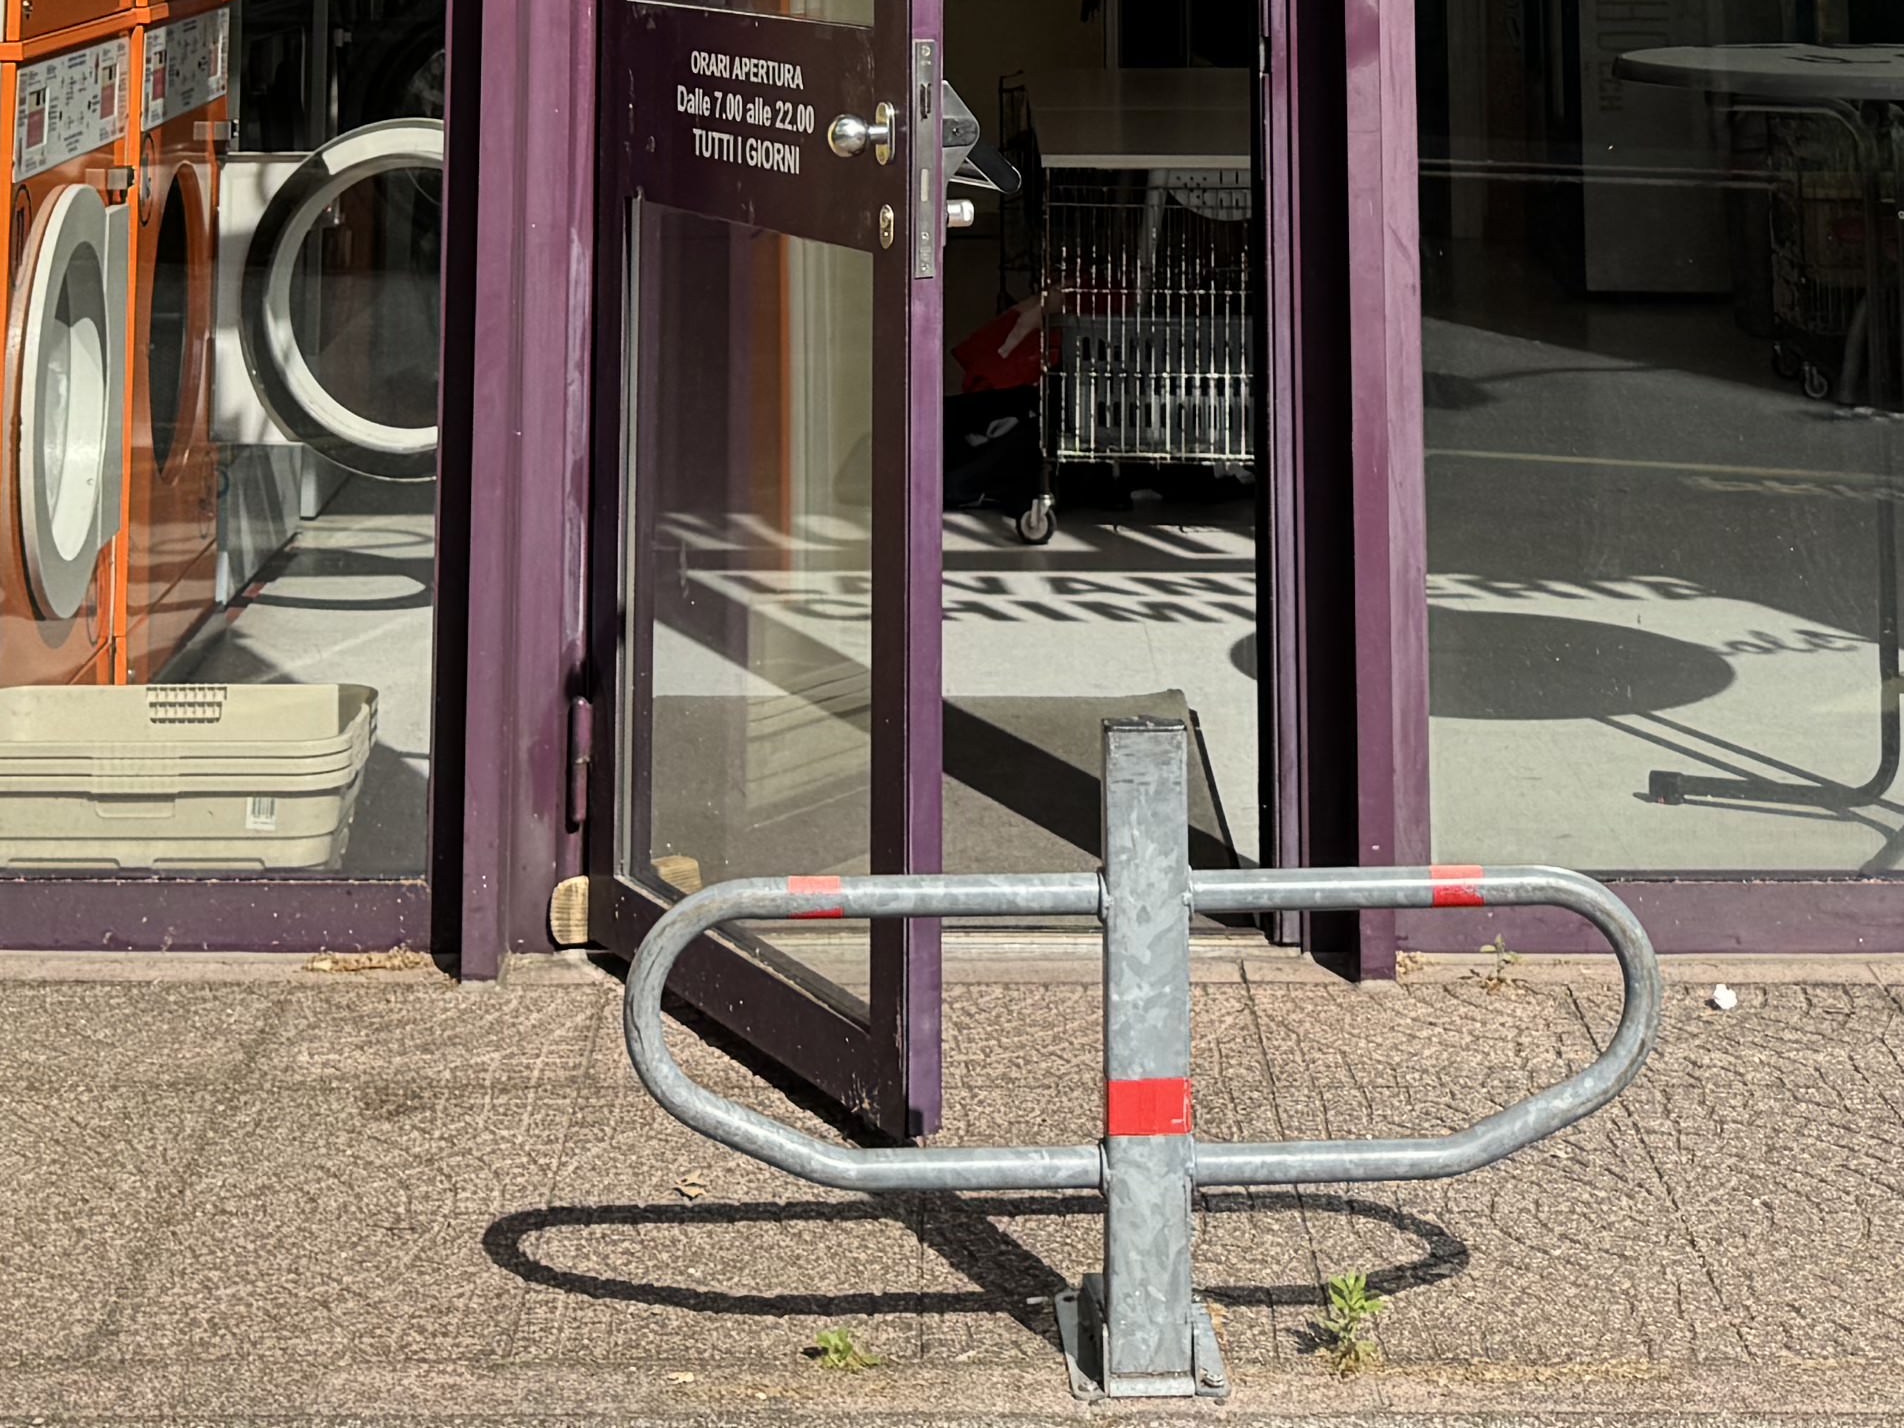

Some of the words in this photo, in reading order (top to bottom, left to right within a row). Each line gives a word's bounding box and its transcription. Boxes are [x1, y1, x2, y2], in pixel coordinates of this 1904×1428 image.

[690, 50, 731, 78] ORARI
[732, 57, 804, 91] APERTURA
[676, 85, 711, 117] Dalle
[714, 91, 743, 123] 7.00
[746, 96, 772, 127] alle
[775, 101, 816, 135] 22.00
[692, 128, 735, 163] TUTTI
[745, 140, 800, 175] GIORNI
